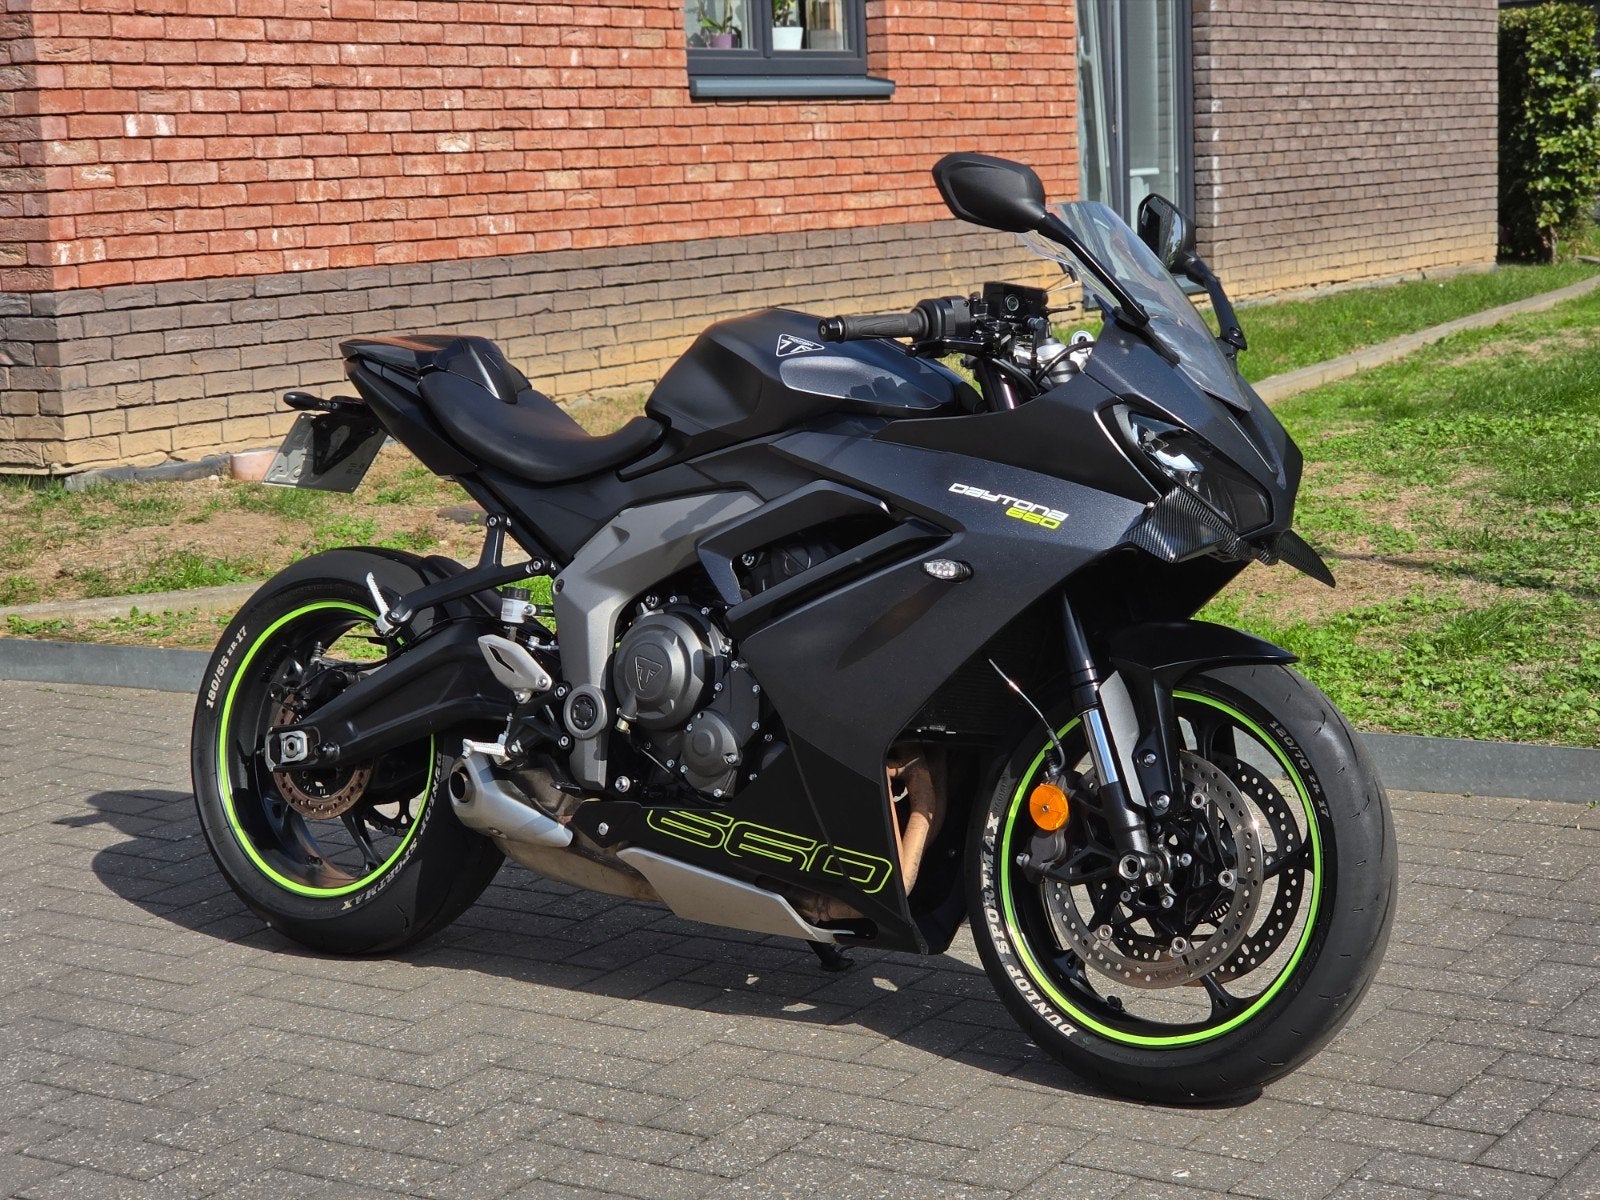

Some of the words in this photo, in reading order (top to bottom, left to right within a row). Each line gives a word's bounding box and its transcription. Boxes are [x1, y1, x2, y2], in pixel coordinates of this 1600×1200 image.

[1005, 506, 1061, 530] 660
[206, 655, 229, 708] 180/55
[236, 625, 247, 643] 17
[1269, 720, 1310, 770] 120/70
[1318, 800, 1330, 818] 17
[341, 837, 418, 911] SPORTMAX
[646, 809, 893, 894] 660
[979, 811, 1012, 956] SPORTMAX
[1005, 962, 1078, 1038] DUNLOP
